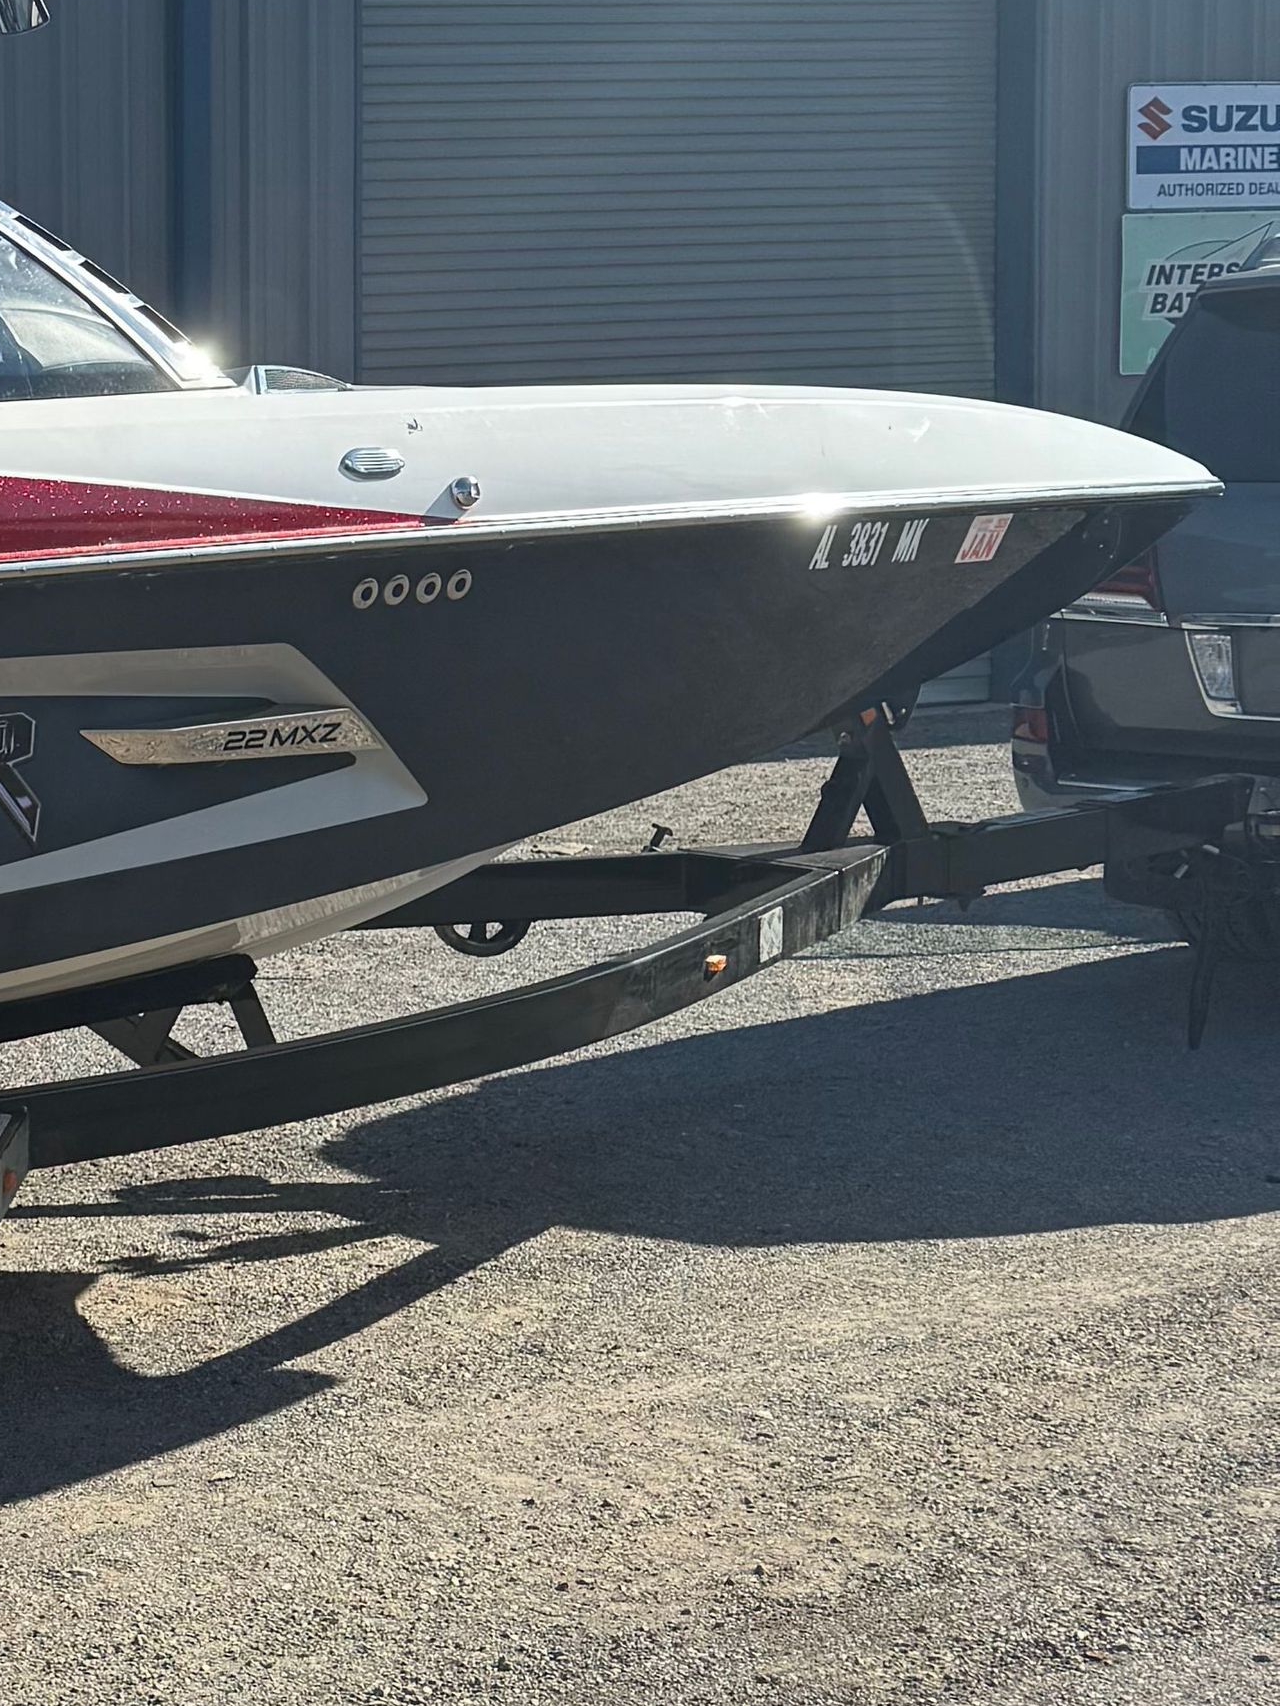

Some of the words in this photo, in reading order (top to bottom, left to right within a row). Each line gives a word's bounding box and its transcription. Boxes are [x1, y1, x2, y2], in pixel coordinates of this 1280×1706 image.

[1181, 104, 1280, 133] SUZU
[1179, 146, 1278, 171] MARINE
[1157, 182, 1244, 197] AUTHORIZED
[808, 524, 838, 570] AL
[841, 521, 889, 567] 3831
[891, 517, 930, 563] MK
[960, 532, 1001, 560] JAN
